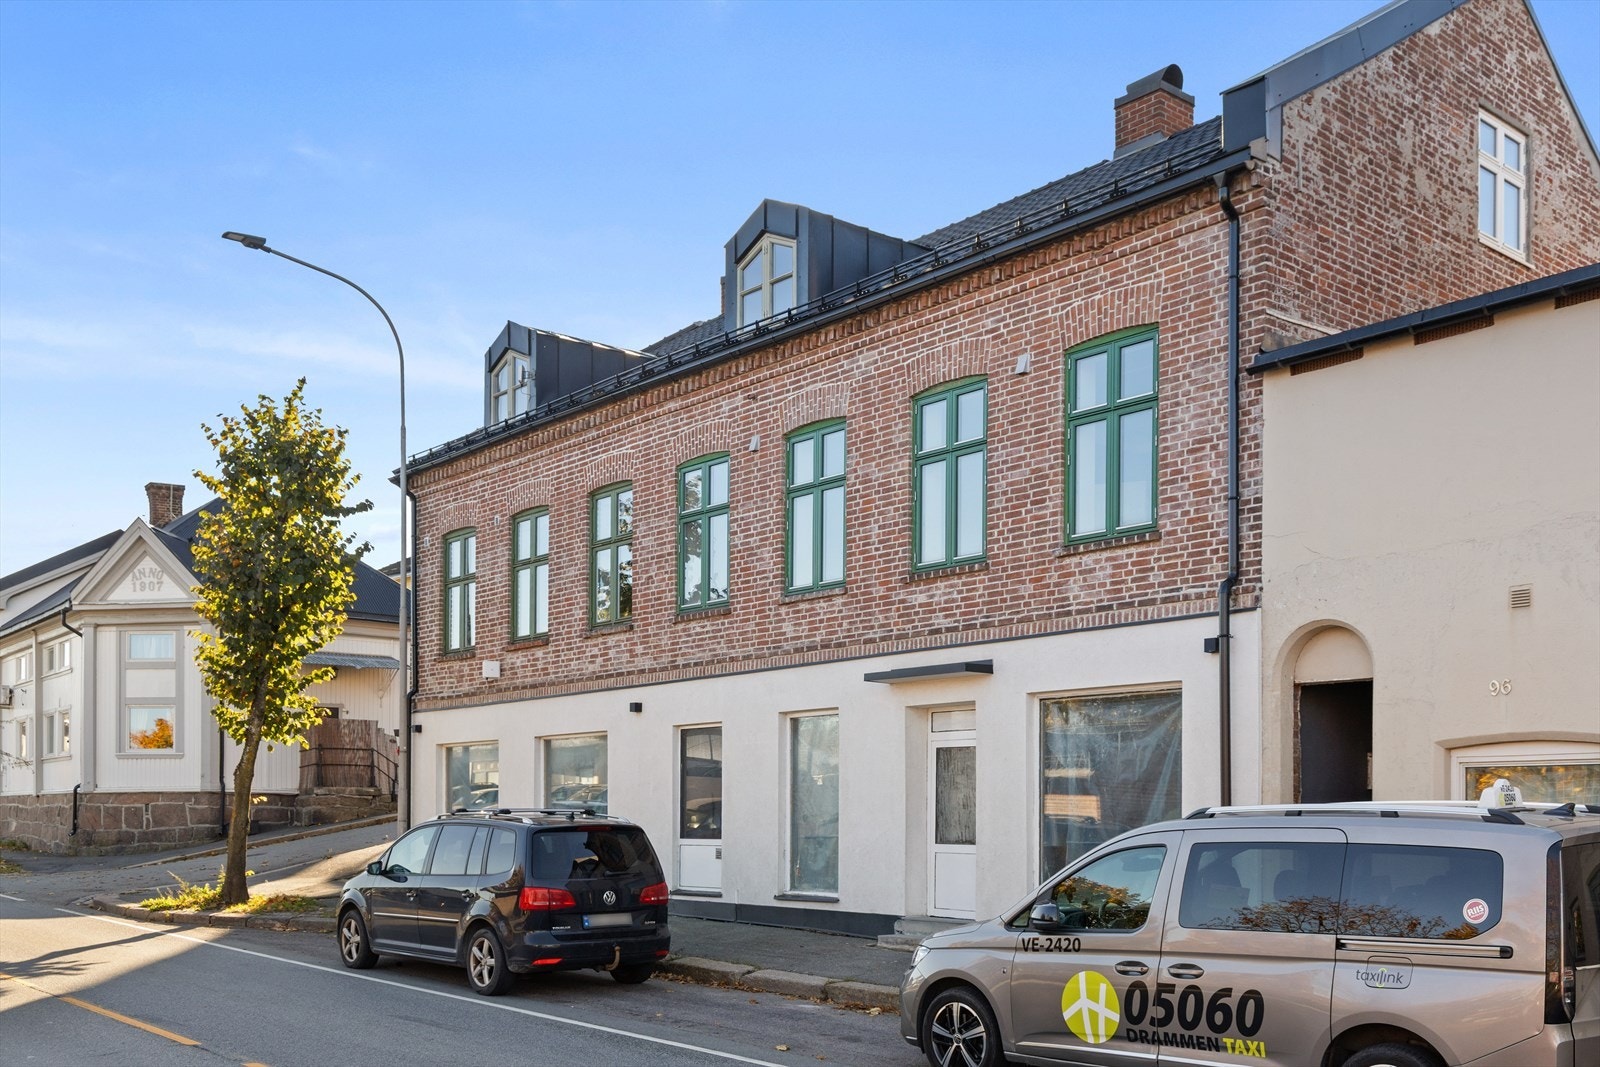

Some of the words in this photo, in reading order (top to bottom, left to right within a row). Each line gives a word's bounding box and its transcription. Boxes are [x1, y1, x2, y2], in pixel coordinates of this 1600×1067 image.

[131, 567, 164, 581] ANNO
[131, 581, 164, 592] 1907
[1489, 679, 1511, 696] 96
[1021, 937, 1081, 953] VE-2420
[1356, 967, 1404, 988] taxilink
[1123, 980, 1265, 1037] 05060
[1126, 1028, 1220, 1053] DRAMMEN
[1222, 1037, 1267, 1058] TAXI
